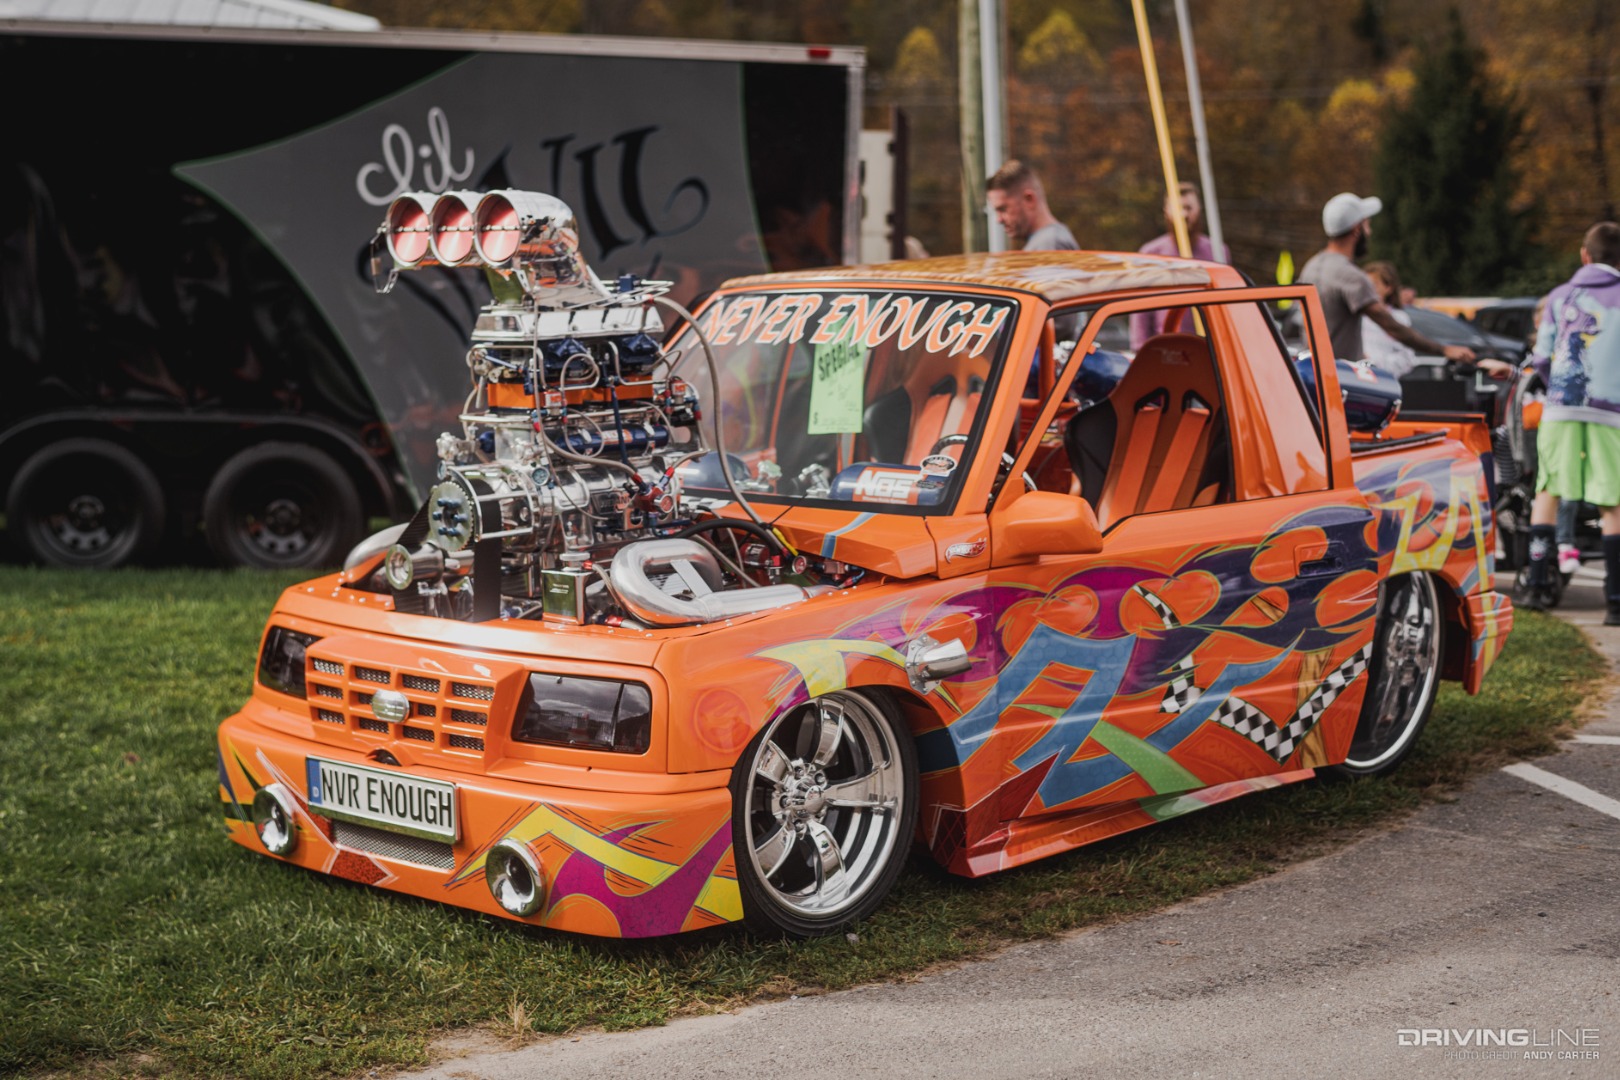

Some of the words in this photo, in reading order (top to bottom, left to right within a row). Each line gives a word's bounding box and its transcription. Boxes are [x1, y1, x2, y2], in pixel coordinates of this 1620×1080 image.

[688, 294, 823, 349] NEVER
[809, 293, 1011, 359] ENOUGH
[321, 767, 360, 809] NVR
[366, 776, 452, 828] ENOUGH
